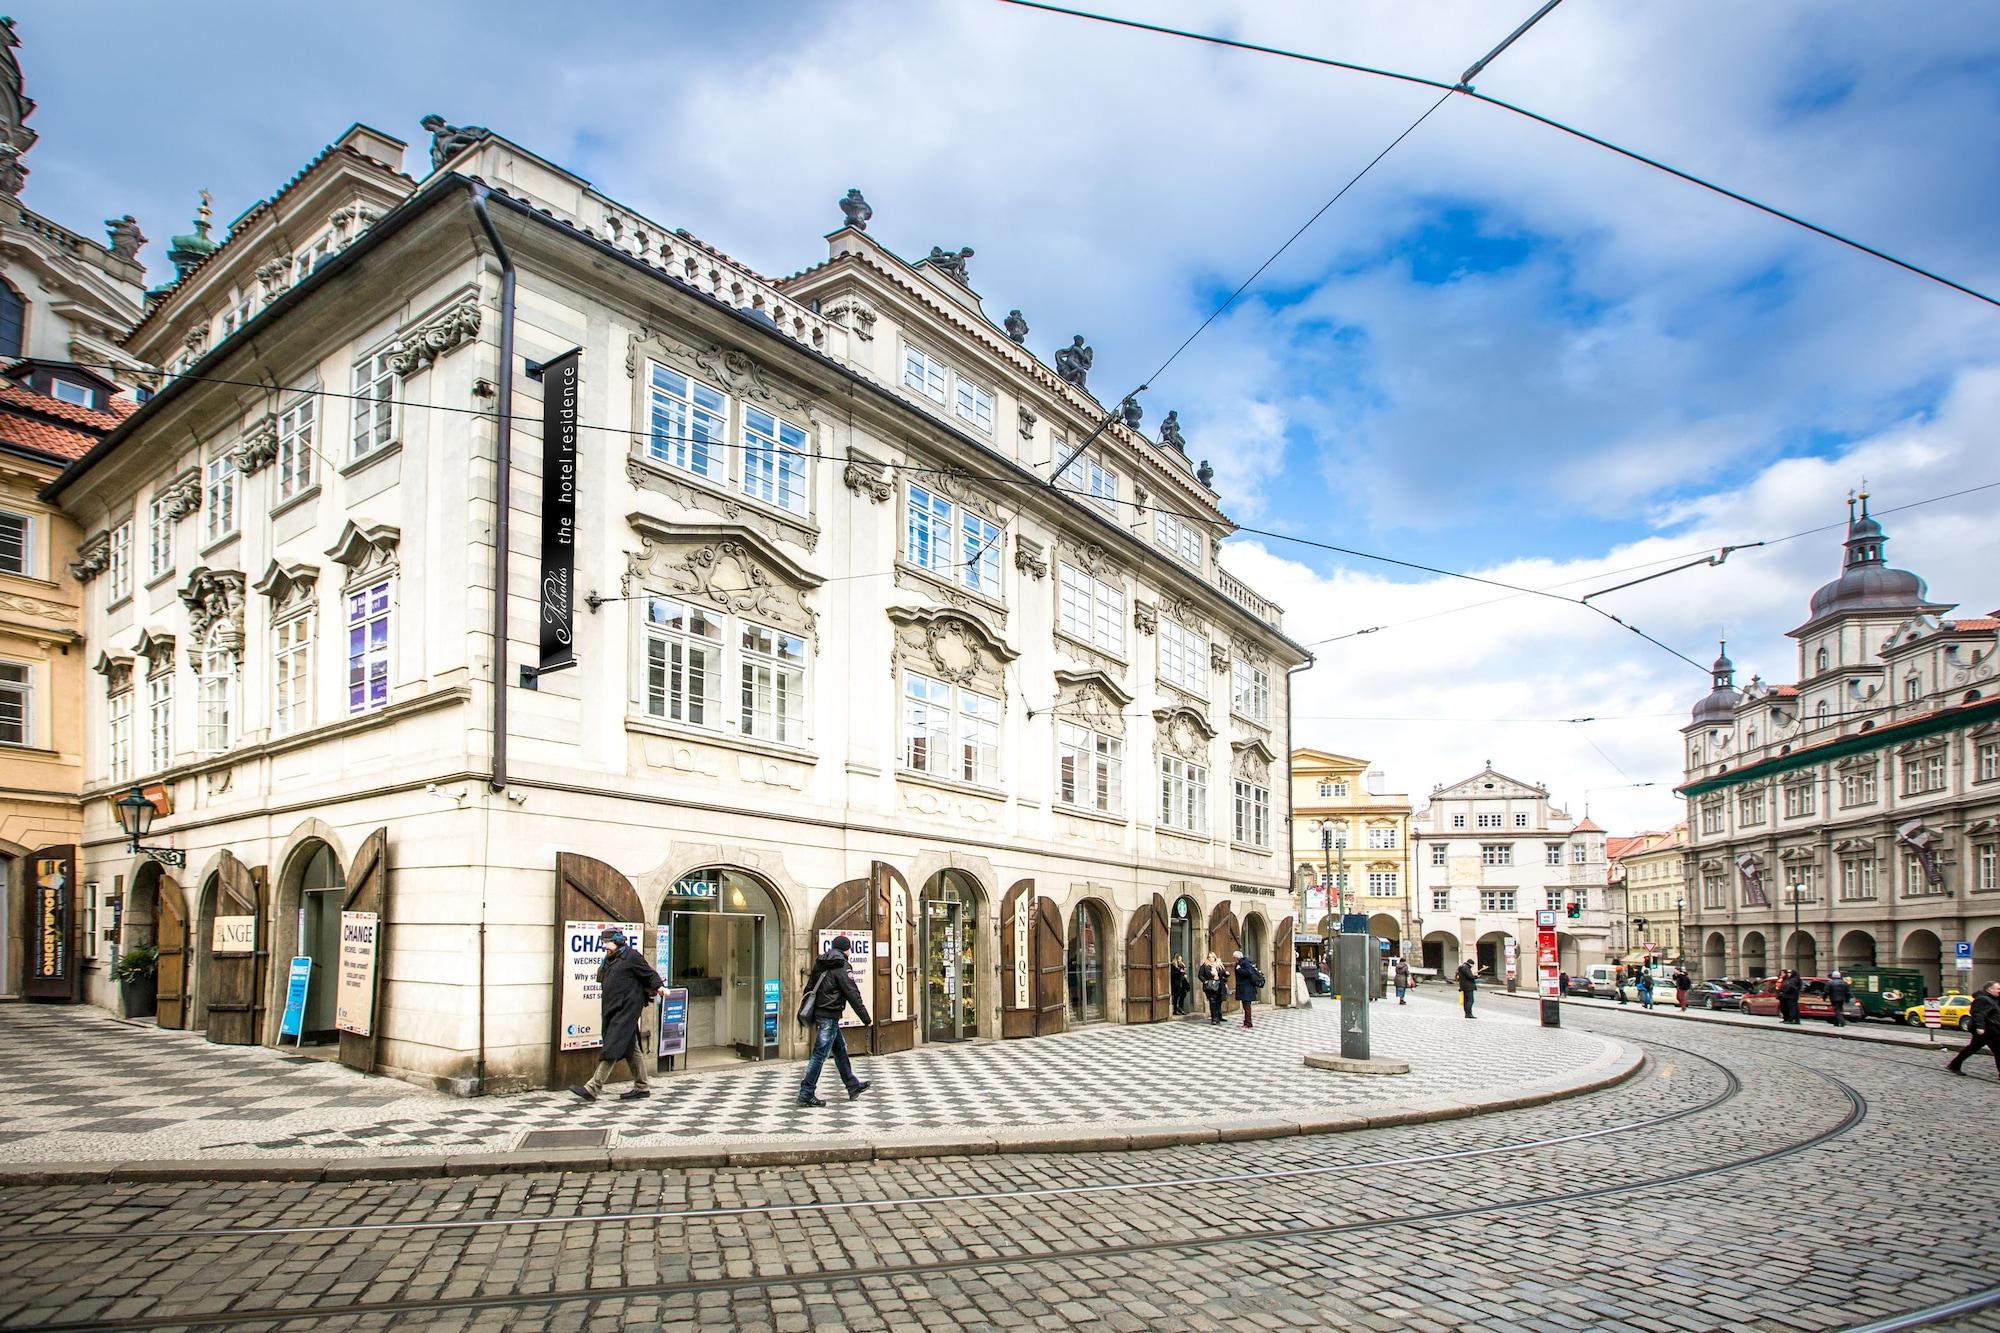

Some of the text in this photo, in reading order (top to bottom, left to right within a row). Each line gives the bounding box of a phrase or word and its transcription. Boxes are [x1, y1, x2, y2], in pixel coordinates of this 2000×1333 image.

[544, 367, 575, 644] Nicholas the hotel residence
[44, 889, 55, 976] BOMBARDINO
[344, 924, 373, 944] CHANGE
[895, 894, 904, 1013] ANTIQUE
[1018, 901, 1027, 1002] ANTIQUE
[1958, 943, 1969, 954] P
[574, 957, 601, 965] WECHSE
[574, 973, 588, 981] Why
[764, 983, 779, 992] ATM
[577, 1024, 591, 1034] ice
